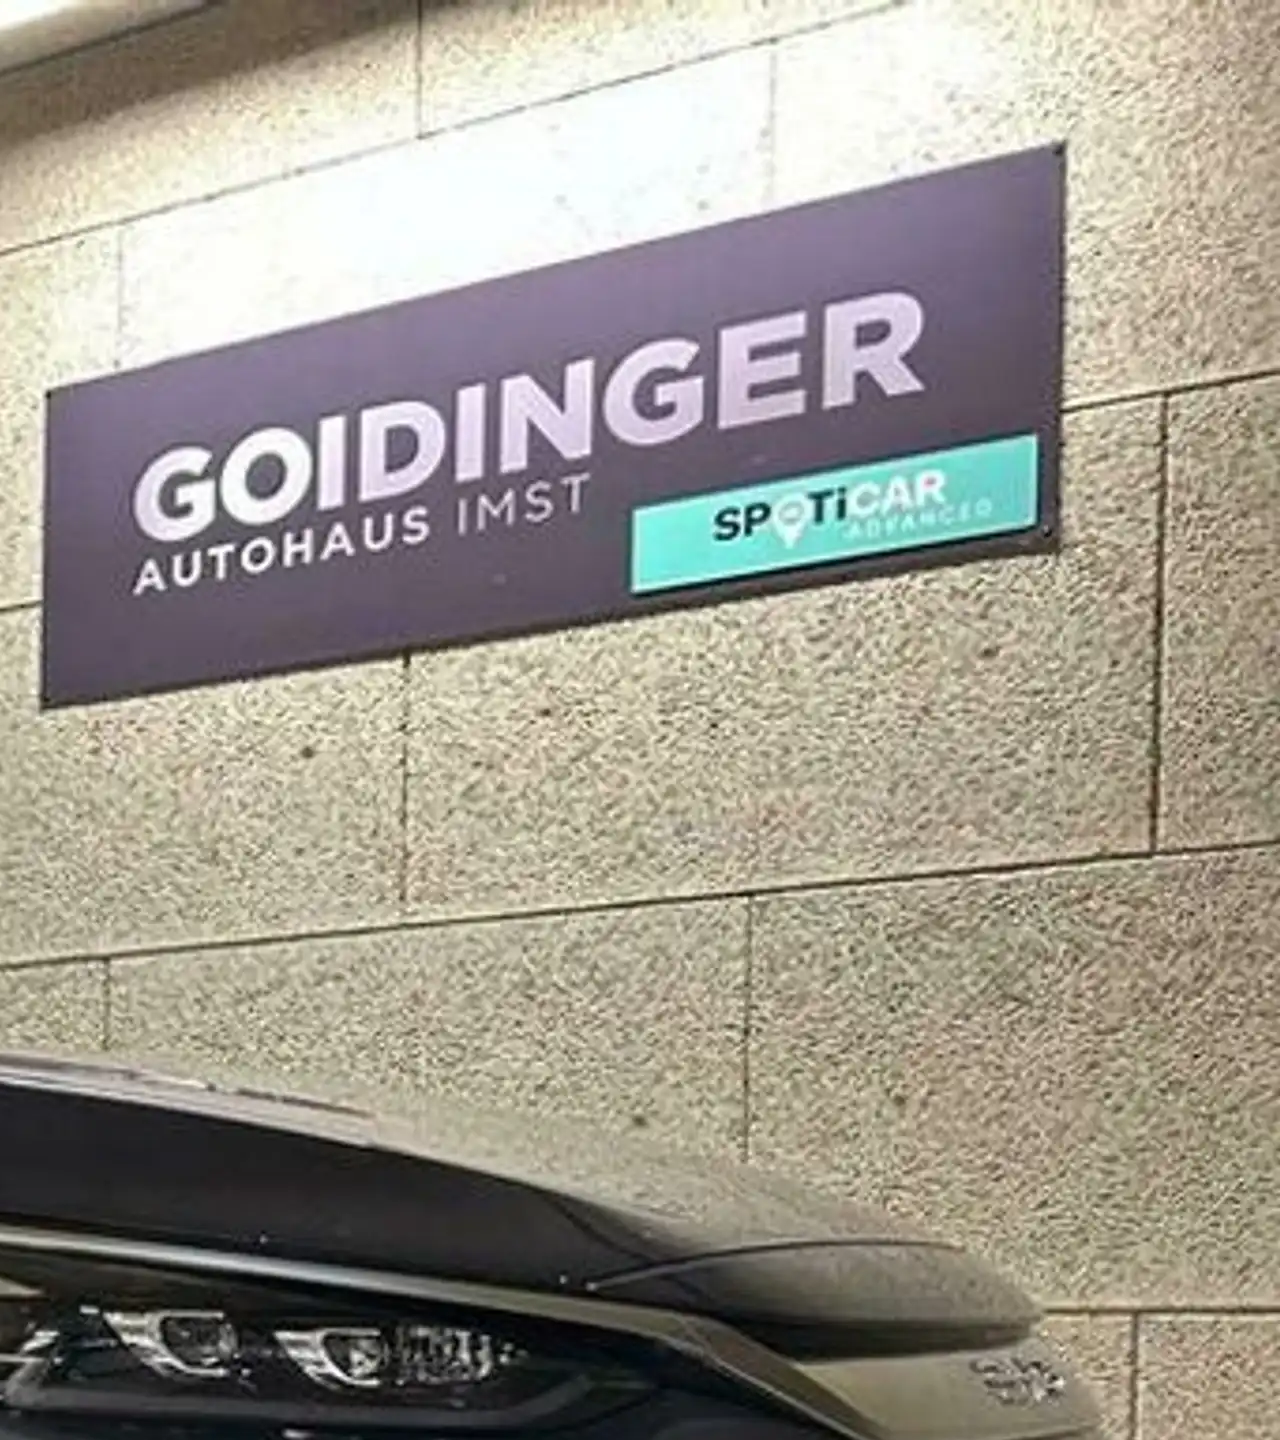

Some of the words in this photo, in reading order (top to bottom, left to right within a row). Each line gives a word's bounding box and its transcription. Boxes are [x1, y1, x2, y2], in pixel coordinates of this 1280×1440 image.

[132, 290, 926, 543] GOIDINGER
[132, 508, 430, 597] AUTOHAUS
[457, 472, 592, 537] IMST
[843, 497, 994, 541] ADVANCED
